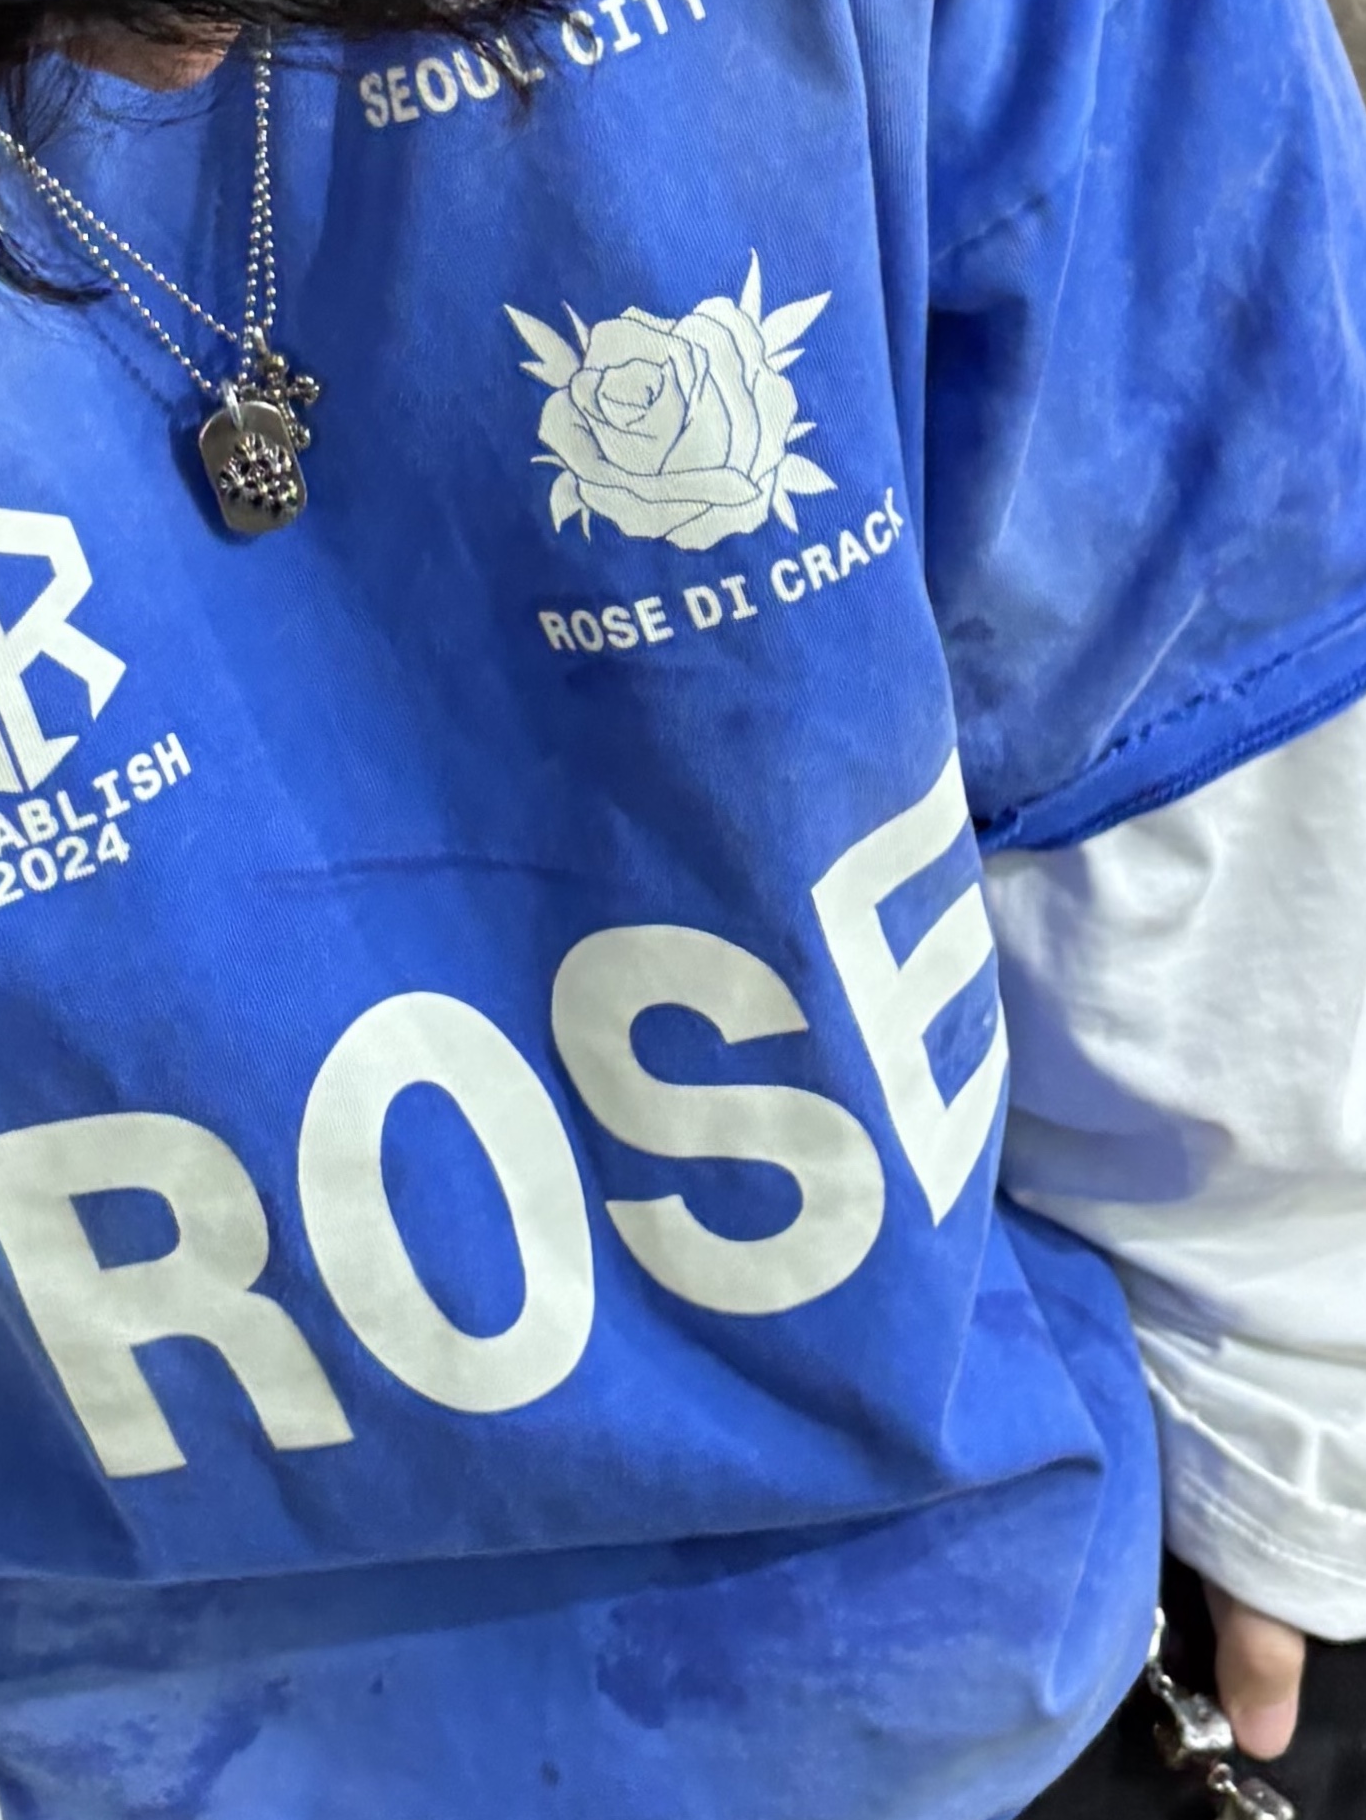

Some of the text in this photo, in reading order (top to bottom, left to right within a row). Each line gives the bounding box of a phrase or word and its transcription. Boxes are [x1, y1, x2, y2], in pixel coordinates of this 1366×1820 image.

[359, 34, 546, 129] SEOUL
[538, 486, 905, 653] ROSE DI CRACK
